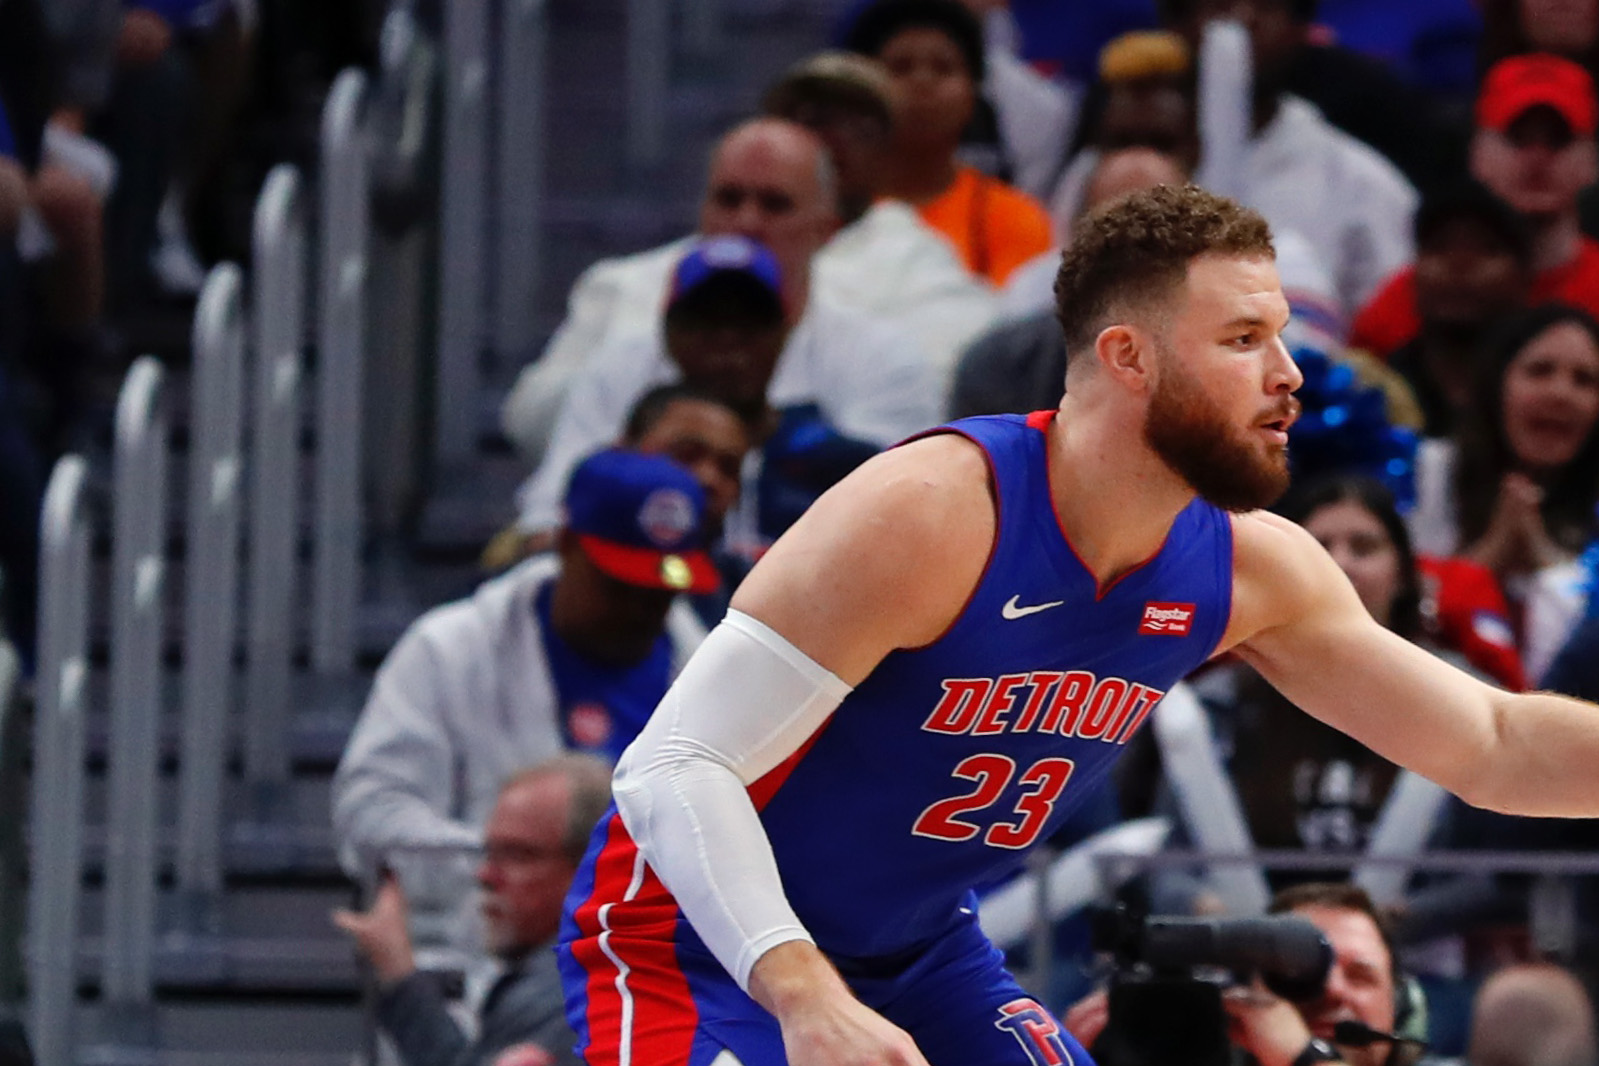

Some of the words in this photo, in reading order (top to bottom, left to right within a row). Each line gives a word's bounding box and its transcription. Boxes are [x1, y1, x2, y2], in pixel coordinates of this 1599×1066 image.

[1144, 606, 1191, 621] Flagstar
[920, 670, 1165, 745] DETROIT
[911, 753, 1075, 850] 23
